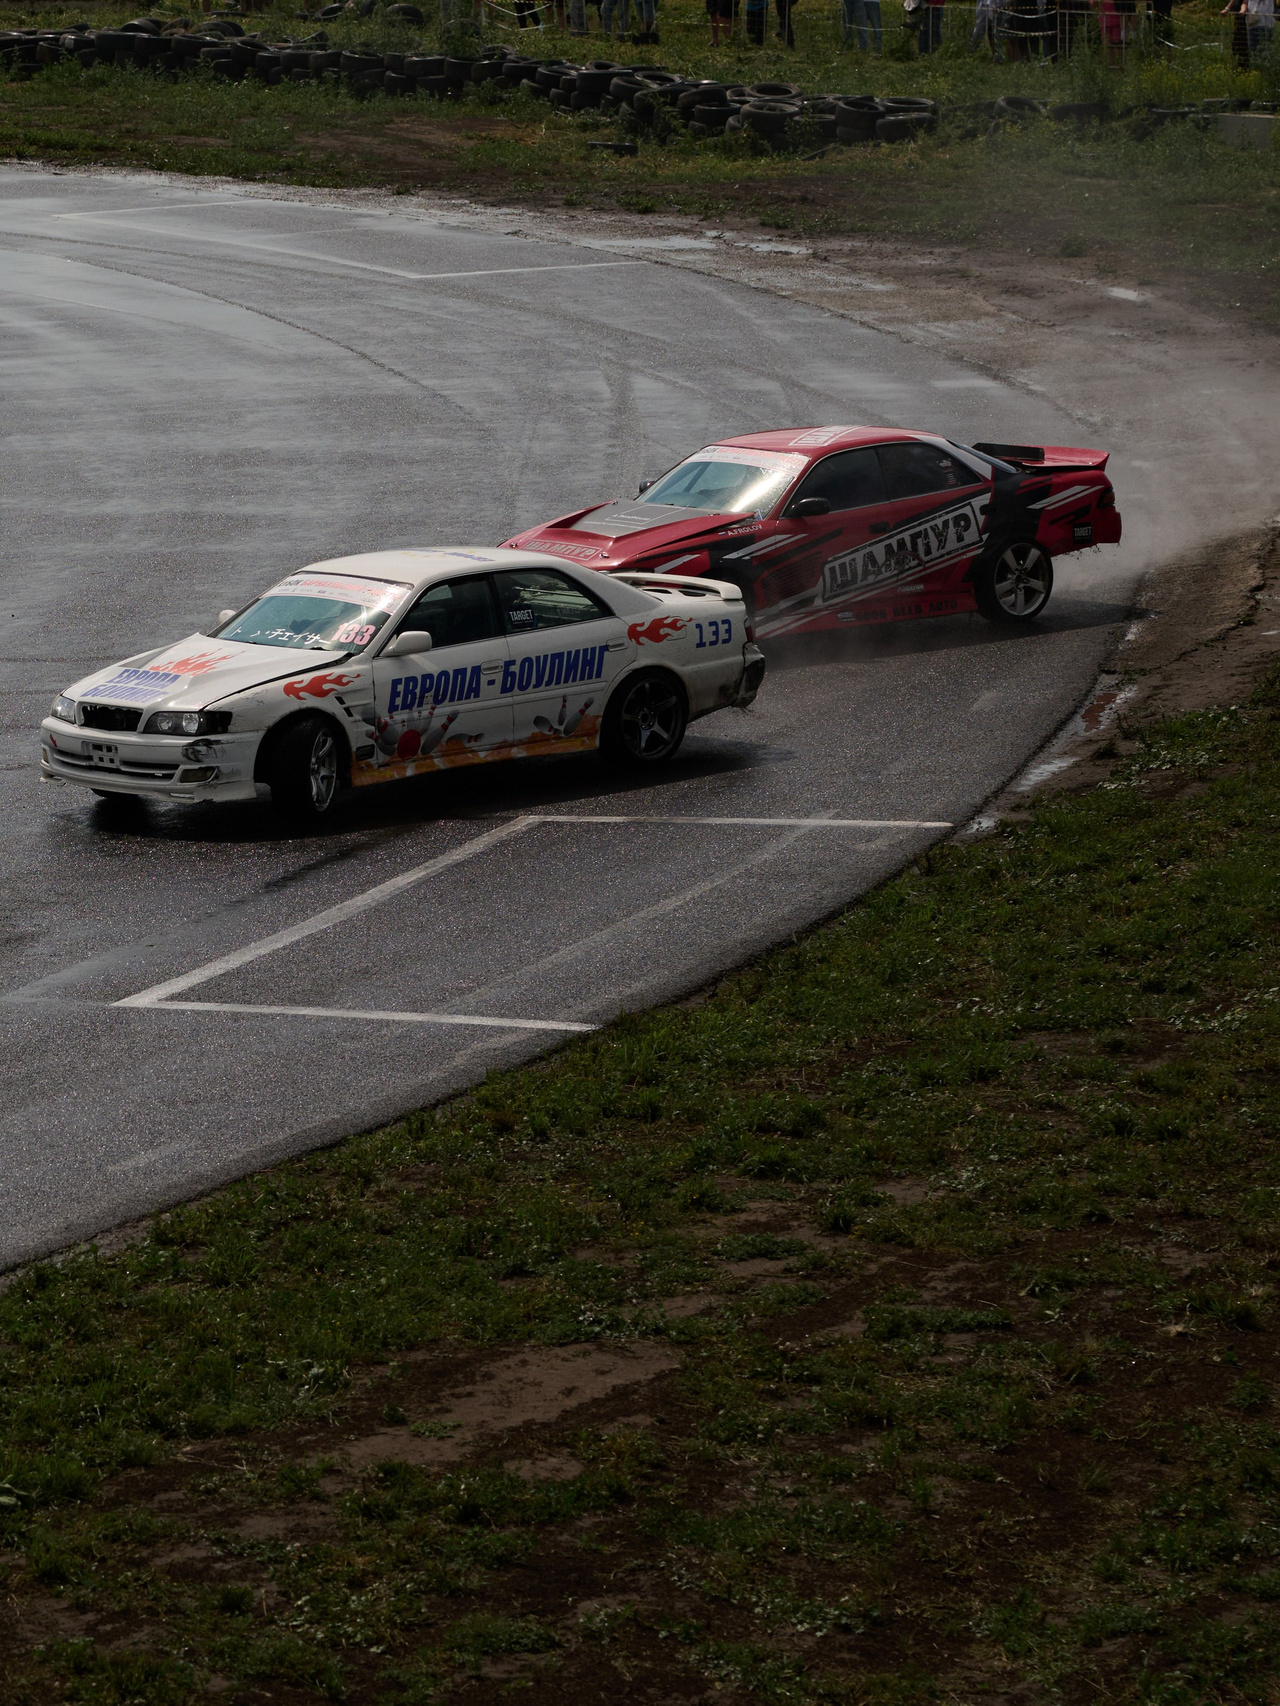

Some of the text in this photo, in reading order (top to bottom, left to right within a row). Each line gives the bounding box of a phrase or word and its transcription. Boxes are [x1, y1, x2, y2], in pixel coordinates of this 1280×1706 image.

[727, 524, 763, 536] A.FROLOV
[1073, 526, 1092, 537] TARGET
[524, 541, 596, 557] ШАМПУР
[828, 512, 972, 592] ШАМПУР
[509, 609, 534, 621] TARGET
[331, 622, 377, 645] 133
[695, 618, 733, 648] 133
[105, 669, 181, 689] ЕВРОПА
[388, 665, 481, 713] ЕВРОПА
[500, 645, 609, 694] БОУЛИНГ
